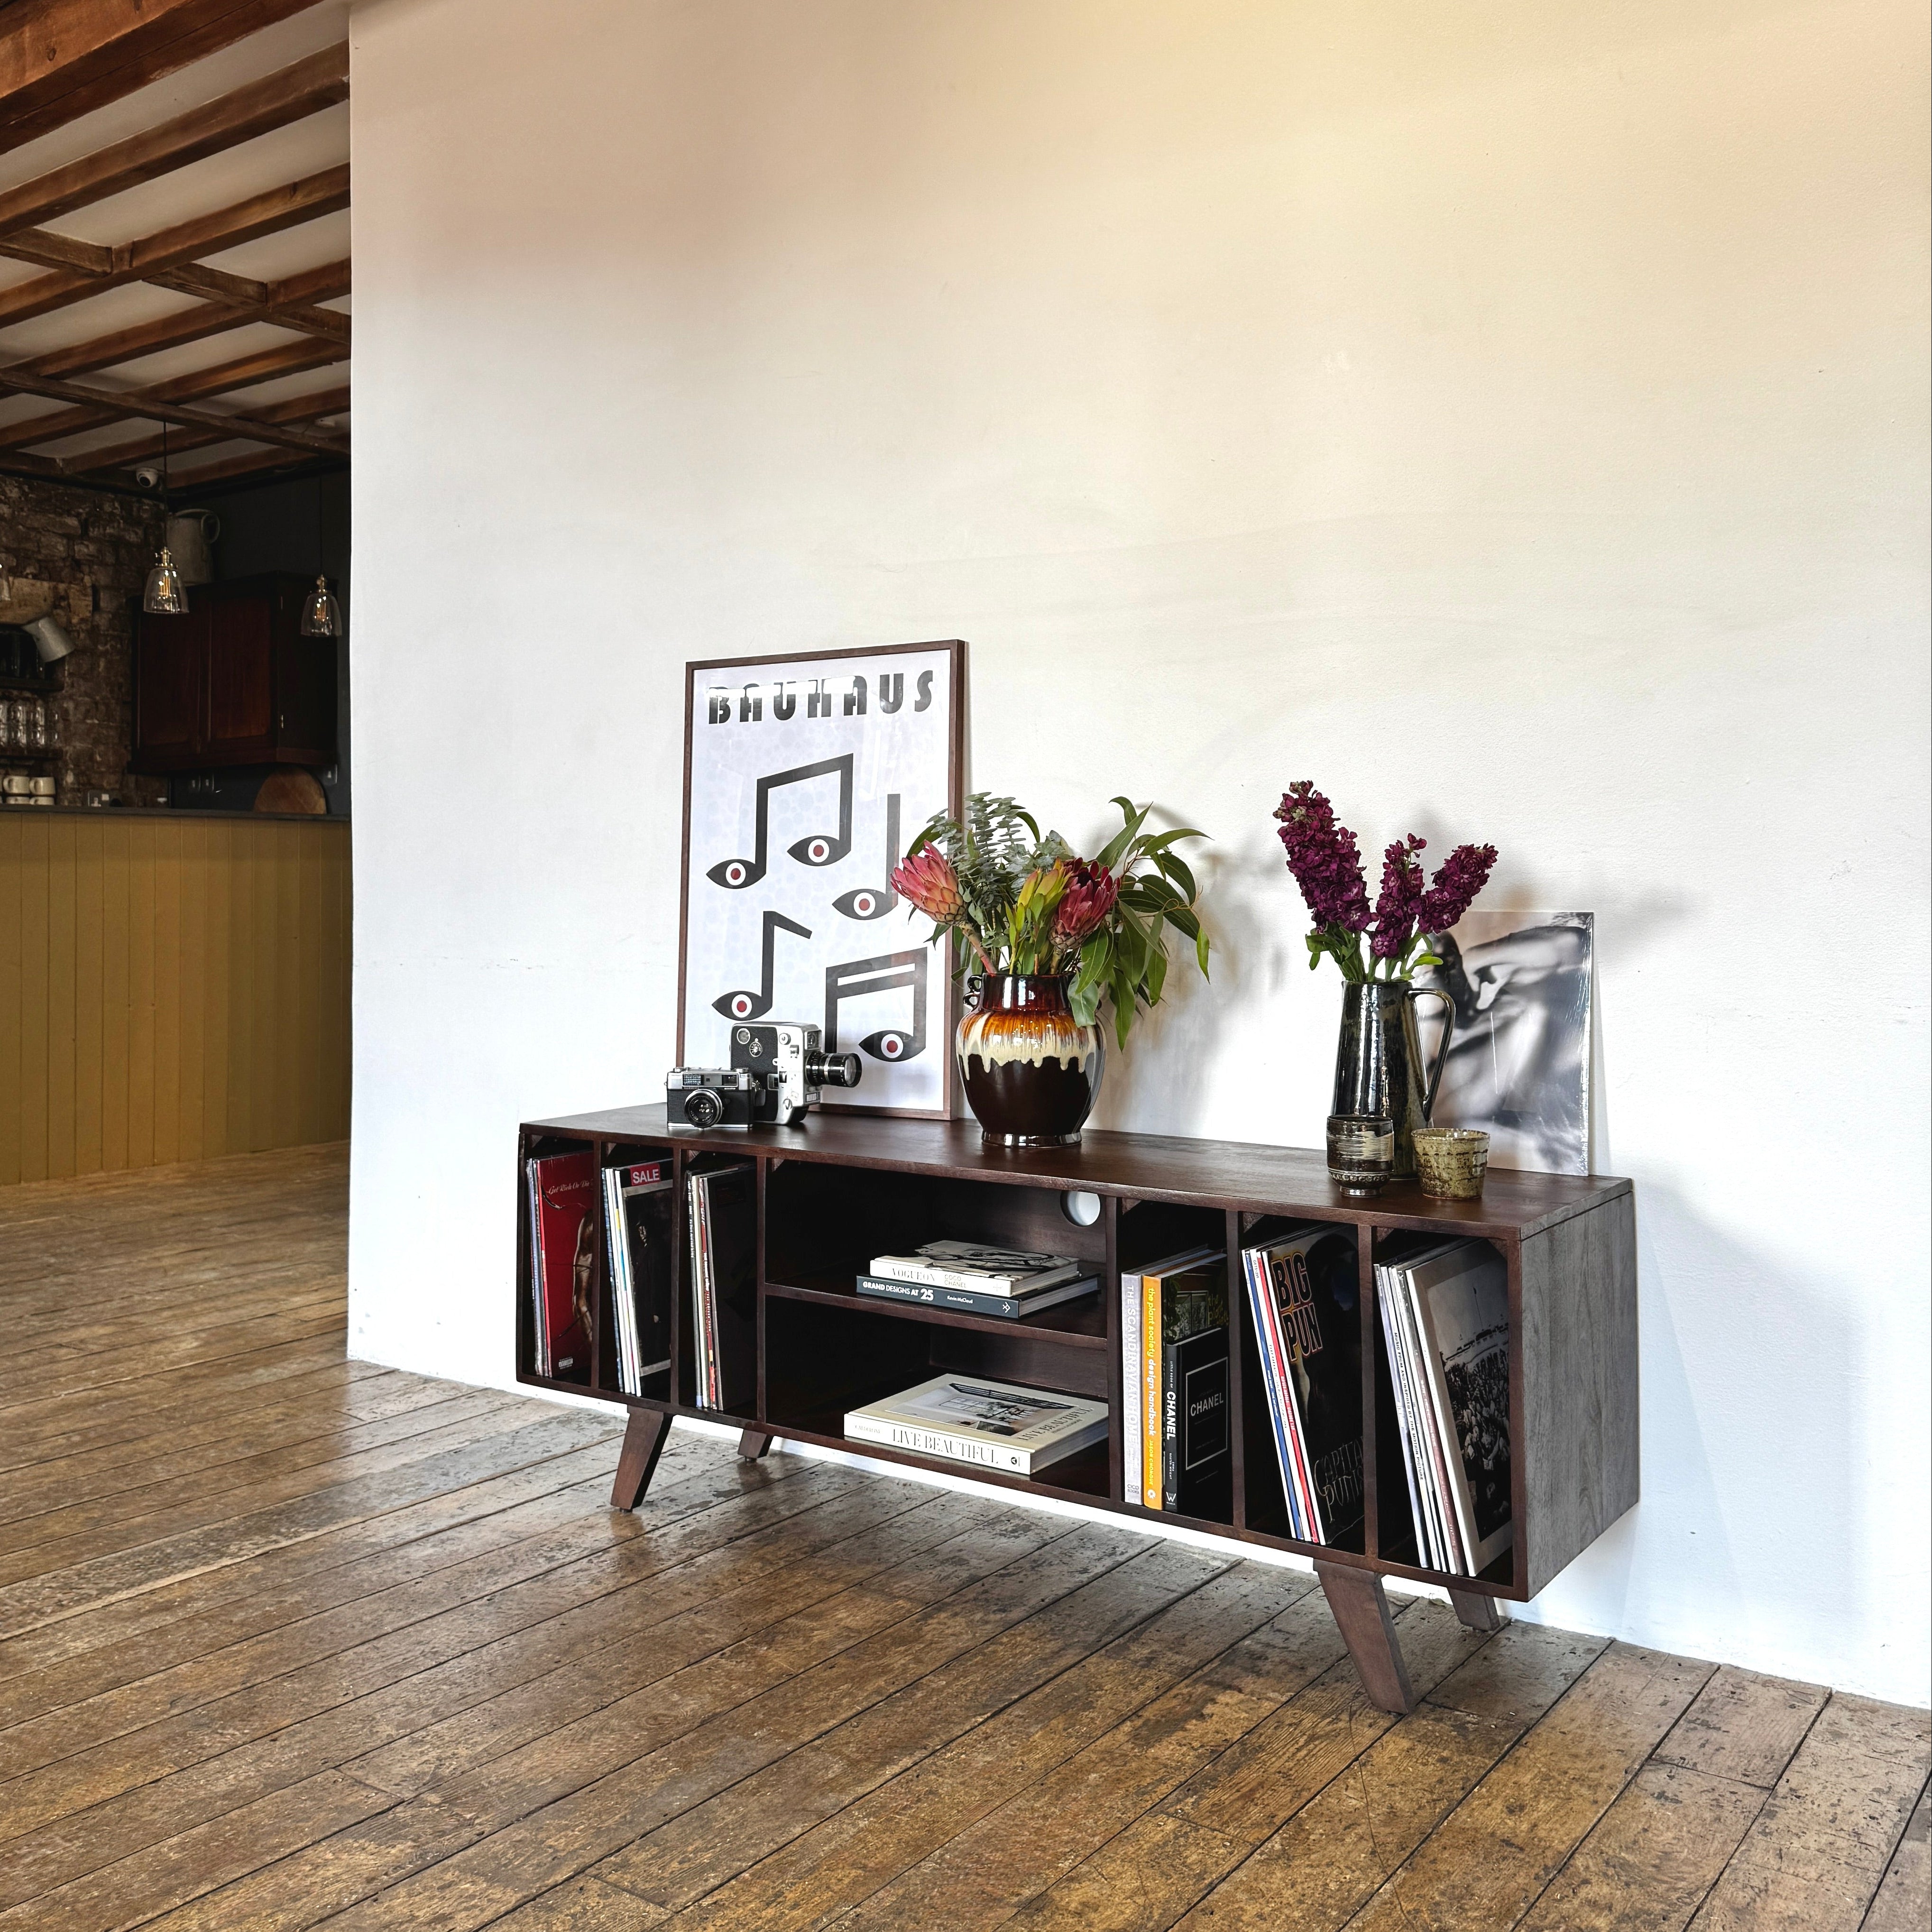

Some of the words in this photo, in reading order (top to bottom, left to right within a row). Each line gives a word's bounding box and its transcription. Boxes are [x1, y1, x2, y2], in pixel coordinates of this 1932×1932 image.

[708, 670, 933, 724] BAUHAUS
[546, 1186, 559, 1195] Get
[633, 1169, 660, 1184] SALE
[892, 1268, 922, 1280] VOGUE
[945, 1280, 966, 1288] CHANEL
[1271, 1252, 1312, 1311] BIG
[863, 1281, 885, 1290] GRAND
[886, 1284, 911, 1295] DESIGNS
[920, 1288, 934, 1301] 25
[1147, 1302, 1156, 1325] plant
[1147, 1325, 1156, 1357] society
[1281, 1302, 1323, 1362] PUN
[1127, 1308, 1137, 1401] SCANDINAVIAN
[1147, 1359, 1156, 1389] design
[1149, 1390, 1157, 1436] handbook
[1167, 1391, 1176, 1440] CHANEL
[1191, 1392, 1224, 1417] CHANEL
[1128, 1405, 1138, 1443] HOME
[893, 1429, 920, 1446] LIVE
[925, 1435, 998, 1464] BEAUTIFUL
[1315, 1436, 1363, 1496] CAPITA
